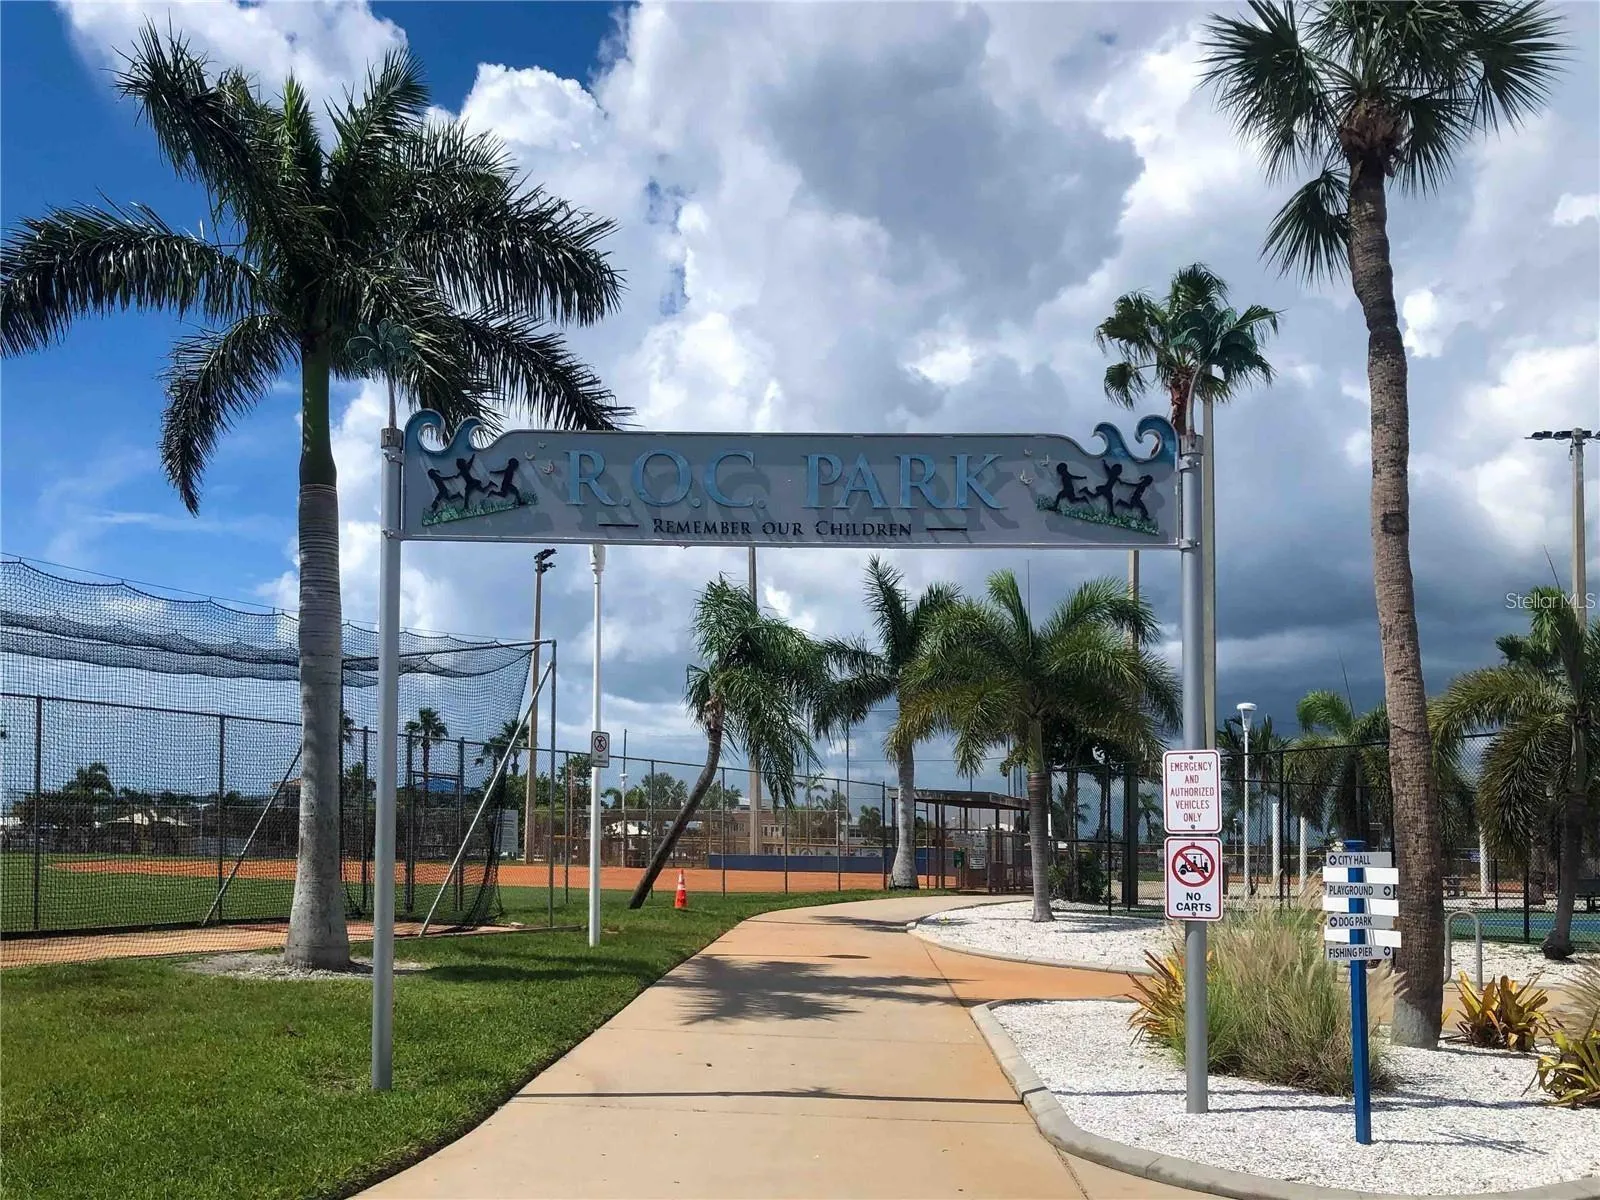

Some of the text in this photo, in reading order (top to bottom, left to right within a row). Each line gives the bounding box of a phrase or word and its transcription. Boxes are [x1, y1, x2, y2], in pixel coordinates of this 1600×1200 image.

[564, 449, 1008, 510] R.O.C. PARK
[653, 518, 912, 537] REMEMBER OUR CHILDREN
[1170, 761, 1212, 772] EMERGENCY
[1184, 774, 1200, 784] AND
[1170, 787, 1215, 797] AUTHORIZED
[1175, 800, 1210, 810] VEHICLES
[1183, 812, 1202, 823] ONLY
[1338, 855, 1371, 865] CITY HALL
[1329, 885, 1374, 896] PLAYGROUND
[1186, 892, 1202, 901] NO
[1176, 902, 1212, 912] CARTS
[1338, 916, 1372, 927] DOG PARK
[1328, 947, 1373, 958] FISHING PIER
